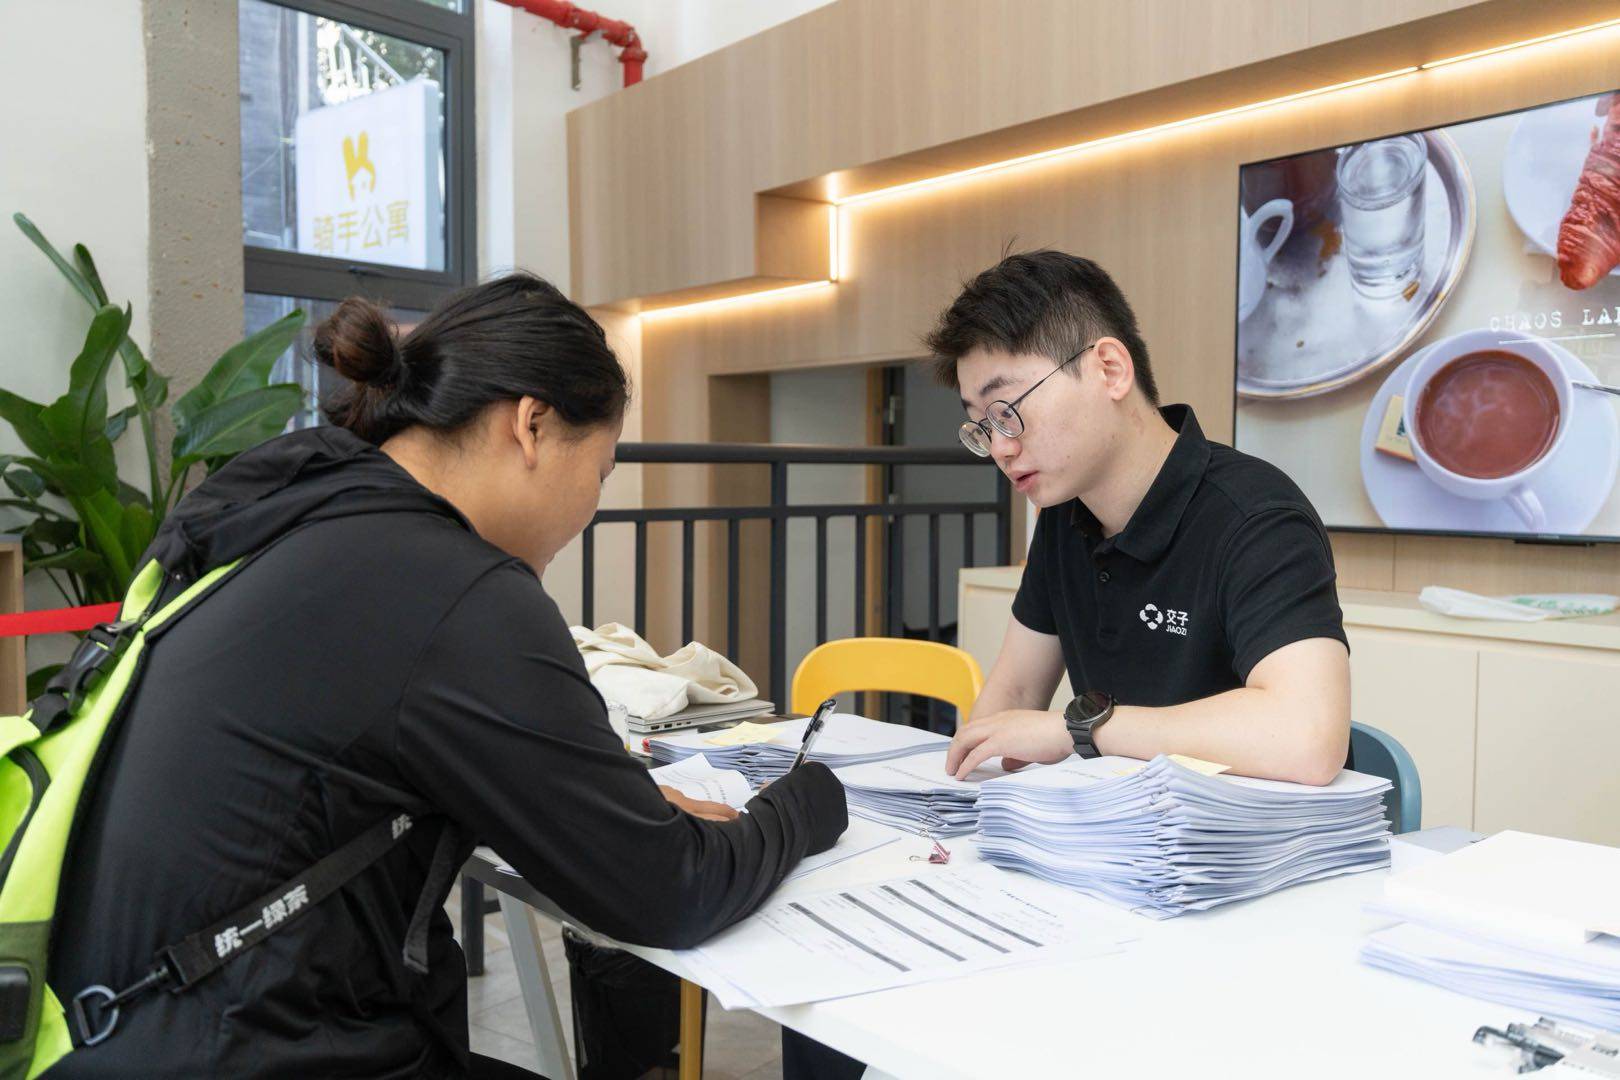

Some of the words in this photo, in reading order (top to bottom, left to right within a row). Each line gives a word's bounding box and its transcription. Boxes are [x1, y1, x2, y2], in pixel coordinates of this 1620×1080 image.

[1489, 310, 1562, 332] CHAOS
[1166, 609, 1189, 626] 交子
[1165, 625, 1188, 636] JIAOZI
[214, 884, 309, 959] 统一绿茶
